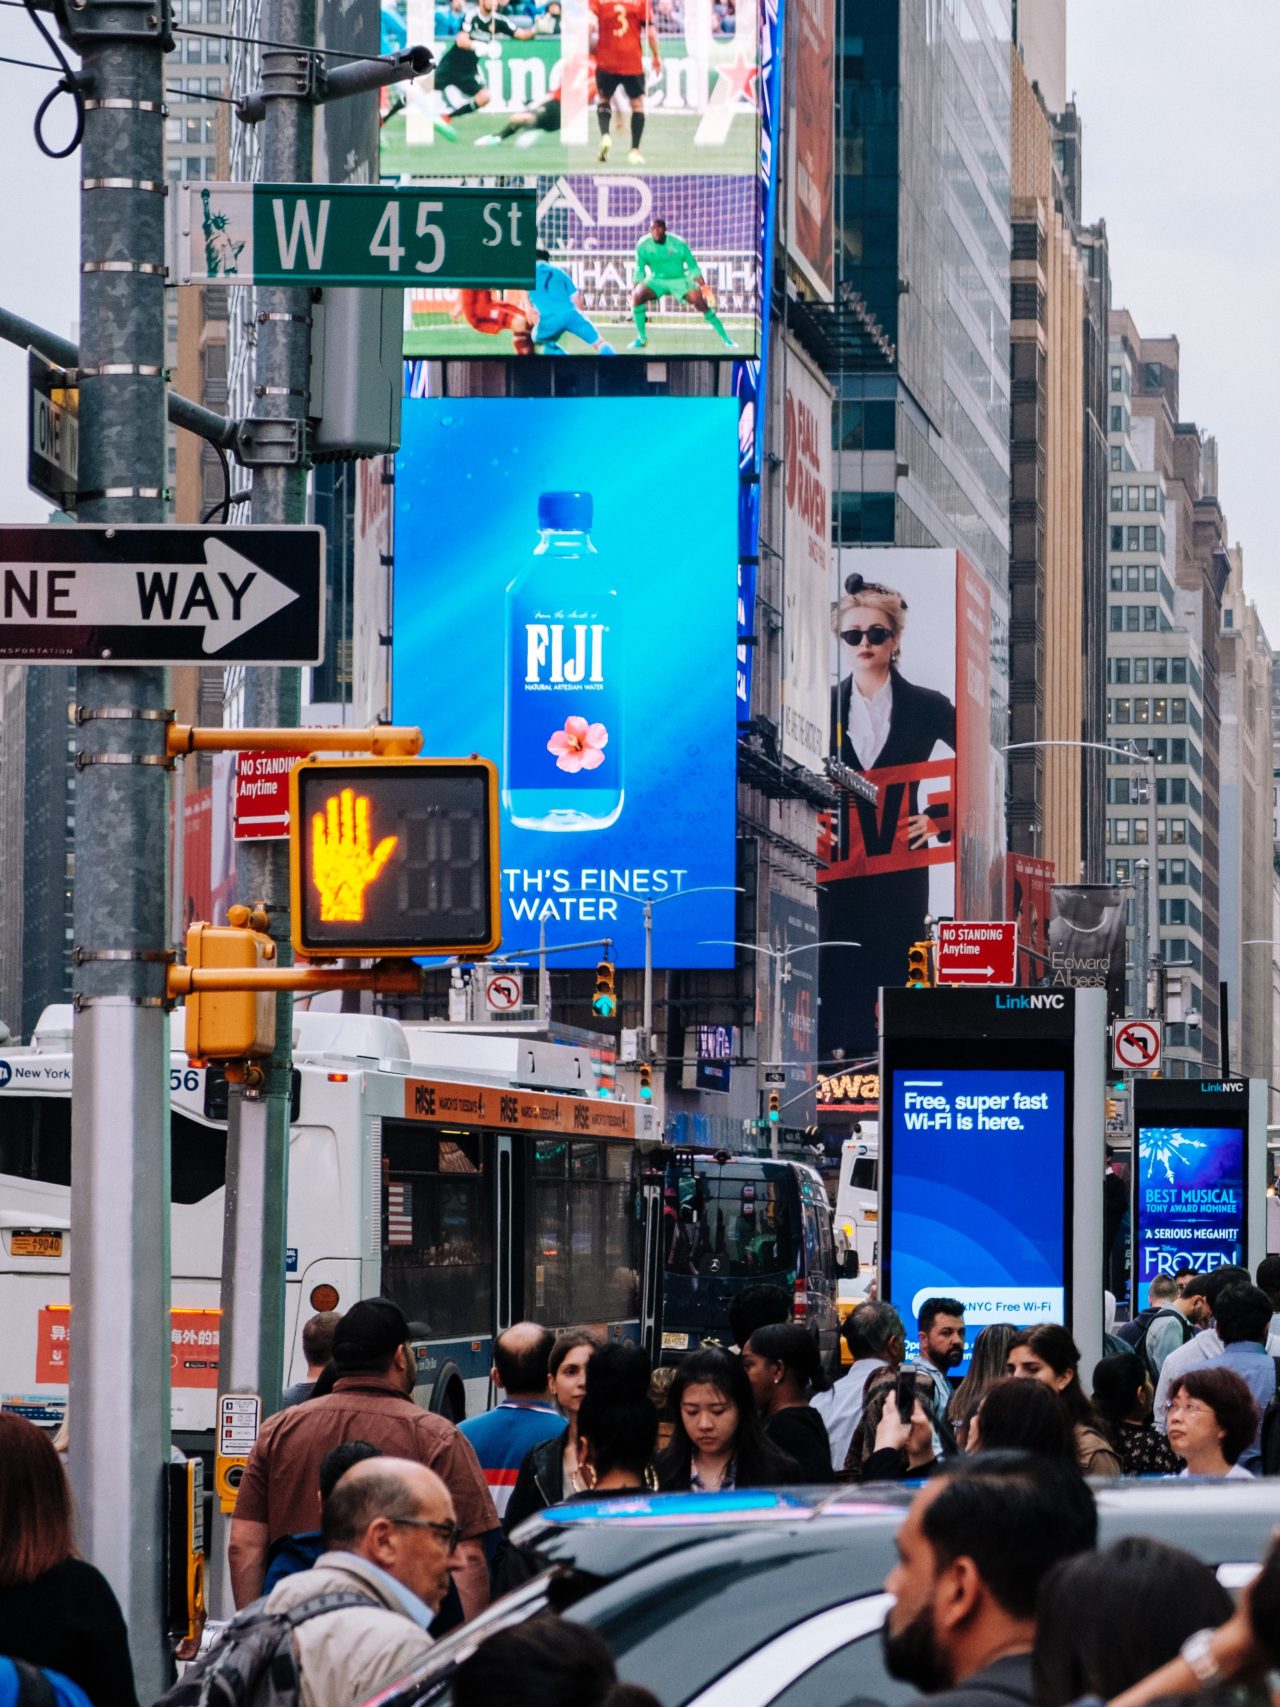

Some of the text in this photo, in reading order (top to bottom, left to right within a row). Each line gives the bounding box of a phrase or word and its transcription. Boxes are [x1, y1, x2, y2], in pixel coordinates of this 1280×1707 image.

[271, 198, 523, 273] W 45 St
[4, 570, 258, 620] NE WAY
[0, 647, 73, 655] NSPORTATION
[524, 623, 605, 683] FIJI
[524, 683, 604, 691] NATURAL ARTESIAN WATER
[241, 756, 302, 776] NO STANDIN
[240, 779, 278, 799] Anytime
[502, 869, 688, 893] TH'S FINEST
[508, 897, 618, 921] WATER
[942, 929, 1003, 941] NO STANDING
[942, 943, 981, 956] Anytime
[1052, 951, 1111, 970] Edward
[1052, 970, 1106, 987] Albee's
[995, 994, 1065, 1009] LinkNYC
[15, 1067, 41, 1079] New
[43, 1067, 71, 1079] York
[170, 1069, 200, 1092] 56
[1201, 1082, 1244, 1092] LinkNYC
[415, 1085, 436, 1115] RISE
[500, 1095, 518, 1123] RISE
[904, 1092, 1049, 1114] Free, super fast
[574, 1103, 589, 1129] RISE
[903, 1112, 1025, 1130] Wi-Fi is here.
[1145, 1188, 1237, 1203] BEST MUSICAL
[1146, 1204, 1237, 1213] TONY AWARD NOMINEE
[1154, 1228, 1192, 1239] SERIOUS
[1144, 1246, 1237, 1277] FROZEN
[996, 1301, 1020, 1312] Free
[1023, 1301, 1052, 1312] Wi-Fi
